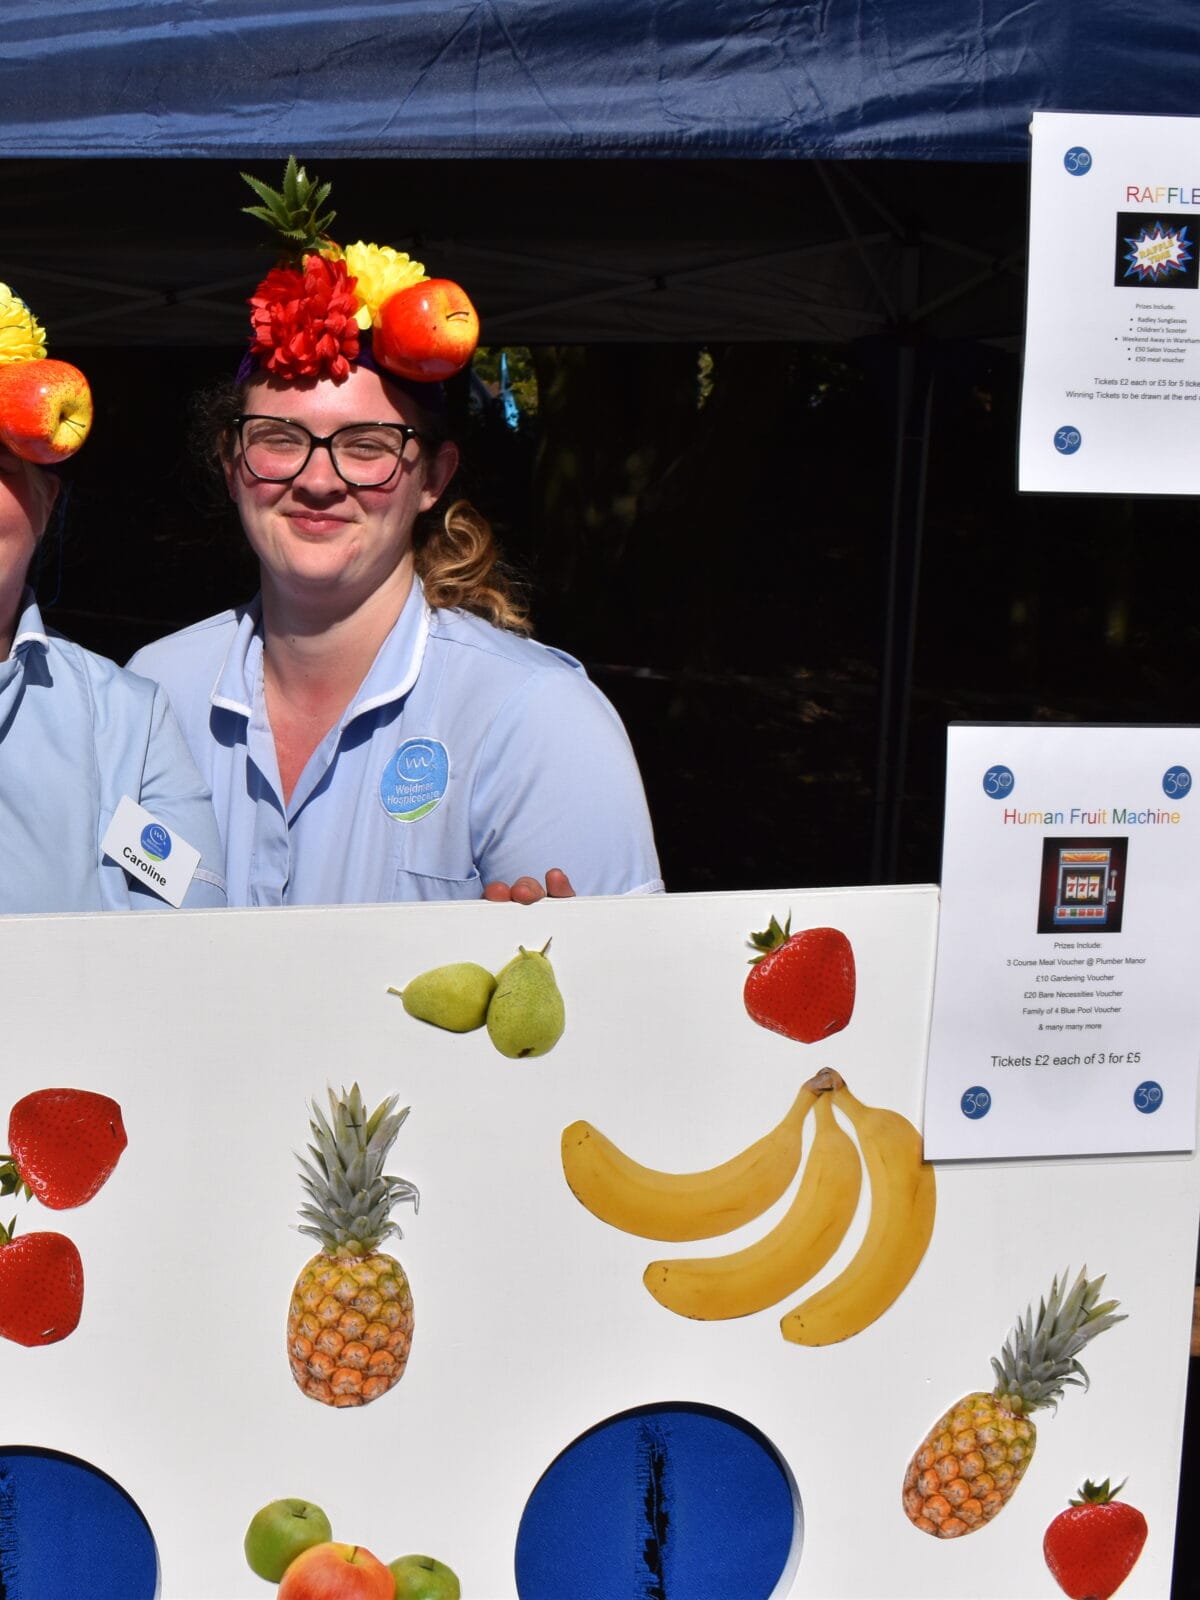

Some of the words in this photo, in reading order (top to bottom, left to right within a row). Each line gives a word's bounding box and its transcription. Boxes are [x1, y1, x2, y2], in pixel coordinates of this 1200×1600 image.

[1126, 185, 1200, 205] RAFFLE
[1094, 377, 1118, 386] Tickets
[1119, 378, 1129, 386] £2
[1130, 378, 1147, 386] each
[1157, 379, 1167, 387] £5
[1168, 379, 1177, 387] for
[1179, 380, 1184, 388] 5
[1065, 391, 1094, 400] Winning
[1096, 391, 1120, 399] Tickets
[1130, 392, 1139, 400] be
[1140, 392, 1162, 400] drawn
[1172, 392, 1183, 401] the
[1184, 393, 1197, 401] end
[1003, 808, 1064, 825] Human
[1070, 808, 1108, 825] Fruit
[1112, 808, 1181, 825] Machine
[122, 846, 168, 887] Caroline
[1053, 941, 1075, 949] Prizes
[1076, 941, 1103, 949] Include:
[1013, 958, 1038, 966] Course
[1039, 958, 1056, 966] Meal
[1057, 958, 1085, 966] Voucher
[1086, 957, 1094, 966] @
[1095, 957, 1124, 965] Plumber
[1124, 956, 1147, 964] Manor
[1050, 974, 1085, 984] Gardening
[1086, 973, 1115, 982] Voucher
[1023, 991, 1037, 999] £20
[1038, 991, 1055, 999] Bare
[1056, 990, 1094, 998] Necessities
[1095, 989, 1124, 998] Voucher
[1022, 1007, 1045, 1016] Family
[1046, 1007, 1054, 1015] of
[1060, 1006, 1077, 1014] Blue
[1077, 1006, 1093, 1014] Pool
[1094, 1005, 1122, 1014] Voucher
[1038, 1023, 1044, 1031] &
[1045, 1024, 1064, 1032] many
[1065, 1023, 1083, 1032] many
[990, 1054, 1032, 1068] Tickets
[1034, 1054, 1050, 1066] £2
[1052, 1053, 1081, 1066] each
[1084, 1053, 1097, 1065] of
[1098, 1052, 1105, 1065] 3
[1108, 1052, 1124, 1064] for
[1126, 1051, 1142, 1064] £5
